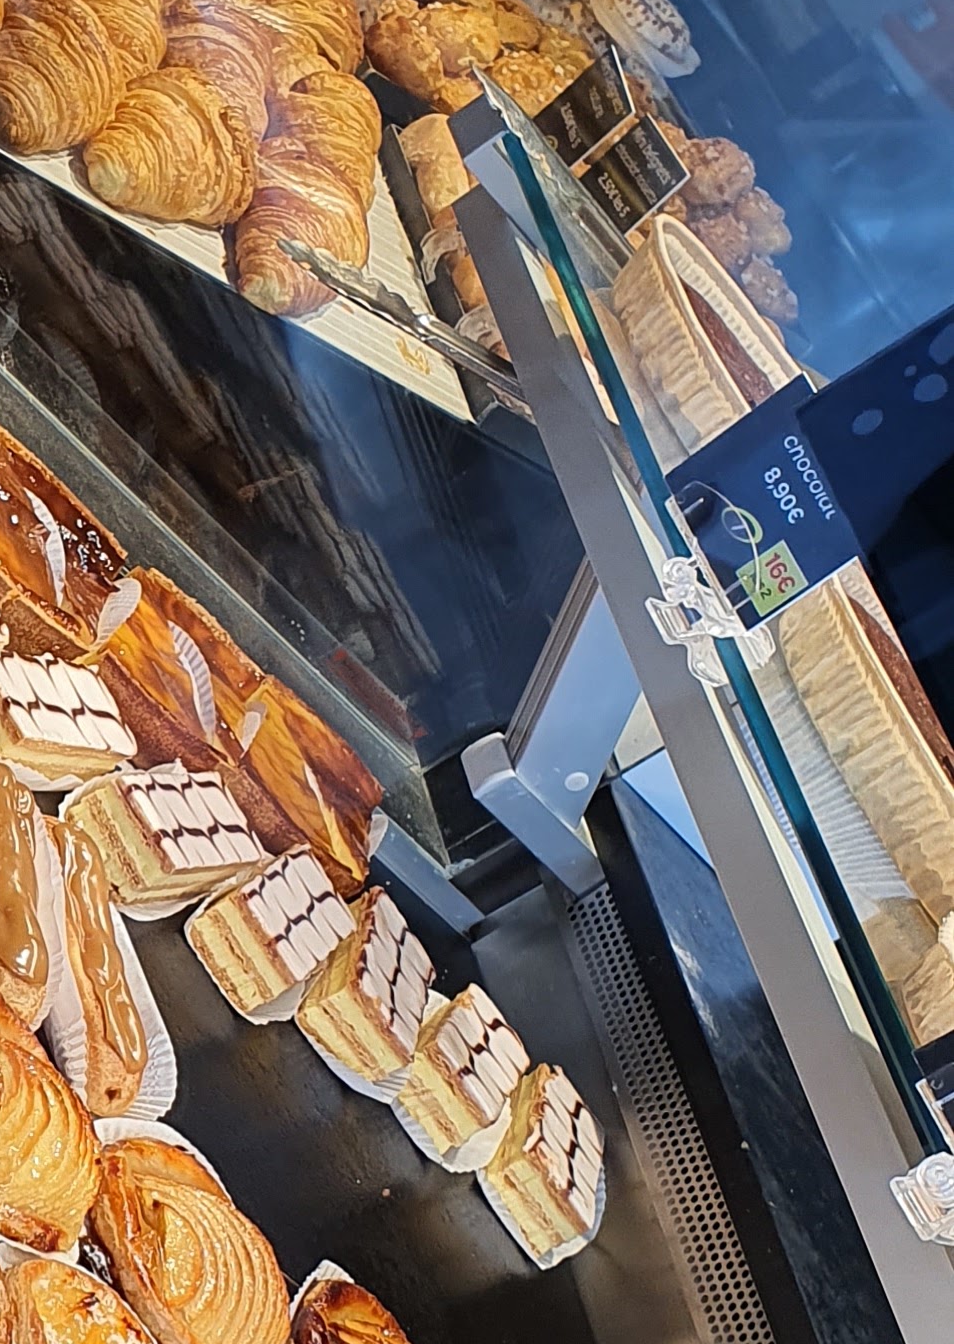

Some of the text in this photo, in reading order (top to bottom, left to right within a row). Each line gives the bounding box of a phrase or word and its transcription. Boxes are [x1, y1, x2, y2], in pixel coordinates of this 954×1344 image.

[619, 206, 631, 218] 5
[763, 466, 805, 524] 8,90€
[765, 552, 796, 594] 16€
